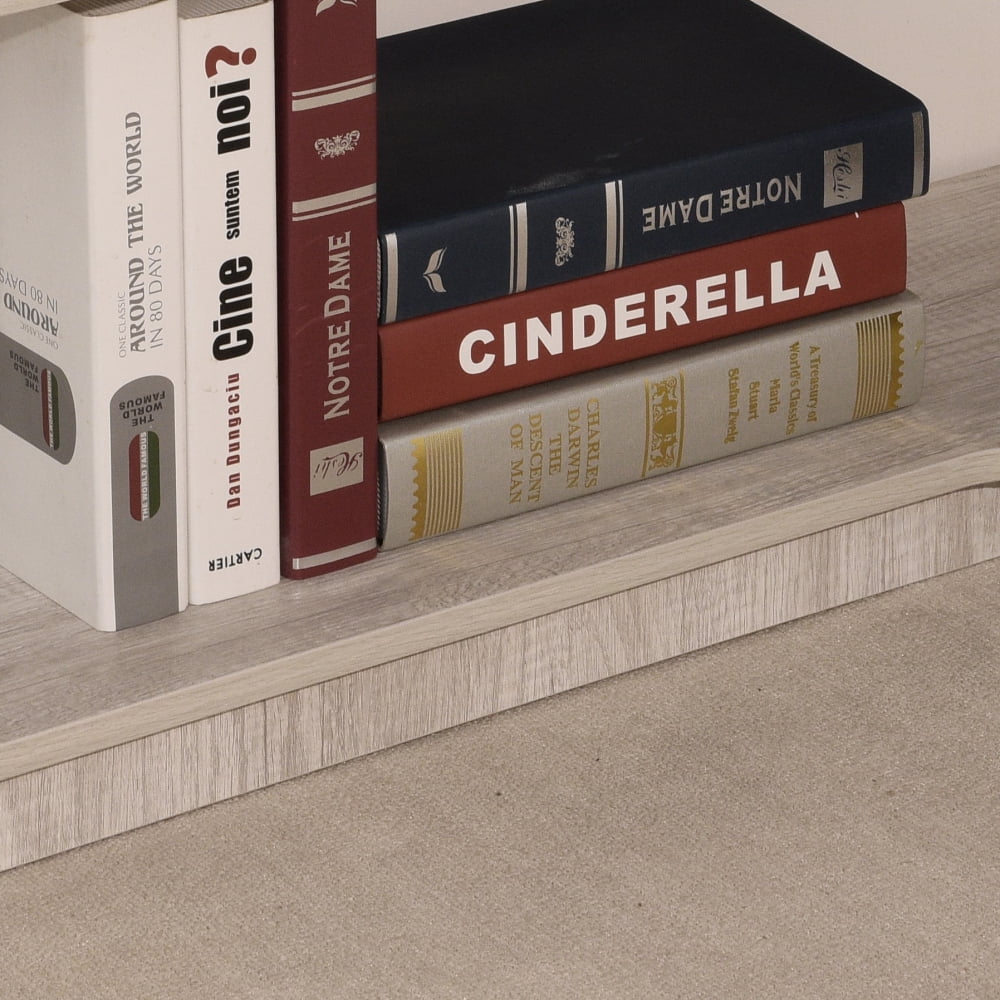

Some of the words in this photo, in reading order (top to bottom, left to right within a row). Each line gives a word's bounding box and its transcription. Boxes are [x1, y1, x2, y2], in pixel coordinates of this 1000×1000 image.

[204, 45, 257, 155] noi?
[125, 112, 142, 195] WORLD
[224, 169, 240, 241] suntem
[642, 193, 714, 233] DAME
[720, 172, 802, 217] NOTRE
[127, 203, 143, 248] THE
[147, 245, 163, 295] DAYS
[323, 231, 351, 320] DAME
[3, 292, 59, 337] AROUND
[30, 285, 43, 305] 80
[46, 294, 58, 315] IN
[117, 291, 127, 333] CLASSIC
[128, 257, 146, 352] AROUND
[149, 300, 163, 322] 80
[212, 255, 254, 362] Cine
[458, 249, 842, 376] CINDERELLA
[118, 335, 127, 359] ONE
[150, 327, 163, 349] IN
[809, 345, 820, 355] A
[9, 350, 39, 374] FAMOUS
[13, 362, 39, 384] WORLD
[323, 319, 351, 421] NOTRE
[789, 341, 801, 387] World's
[807, 354, 821, 409] Treasury
[25, 378, 40, 393] THE
[118, 390, 166, 411] FAMOUS
[728, 367, 740, 409] Stefan
[747, 381, 760, 422] Stuart
[122, 401, 163, 419] WORLD
[131, 413, 155, 427] THE
[225, 372, 241, 467] Dungaciu
[724, 409, 740, 445] Zweig
[786, 388, 801, 436] Classics
[806, 410, 818, 423] of
[140, 431, 148, 468] FAMOUS
[510, 423, 523, 450] OF
[527, 413, 543, 502] DESCENT
[548, 433, 562, 476] THE
[566, 408, 581, 489] DARWIN
[584, 397, 600, 489] CHARLES
[141, 469, 149, 501] WORLD
[226, 472, 241, 509] Dan
[509, 457, 523, 504] MAN
[141, 502, 149, 521] THE
[208, 547, 263, 572] CARTIER
